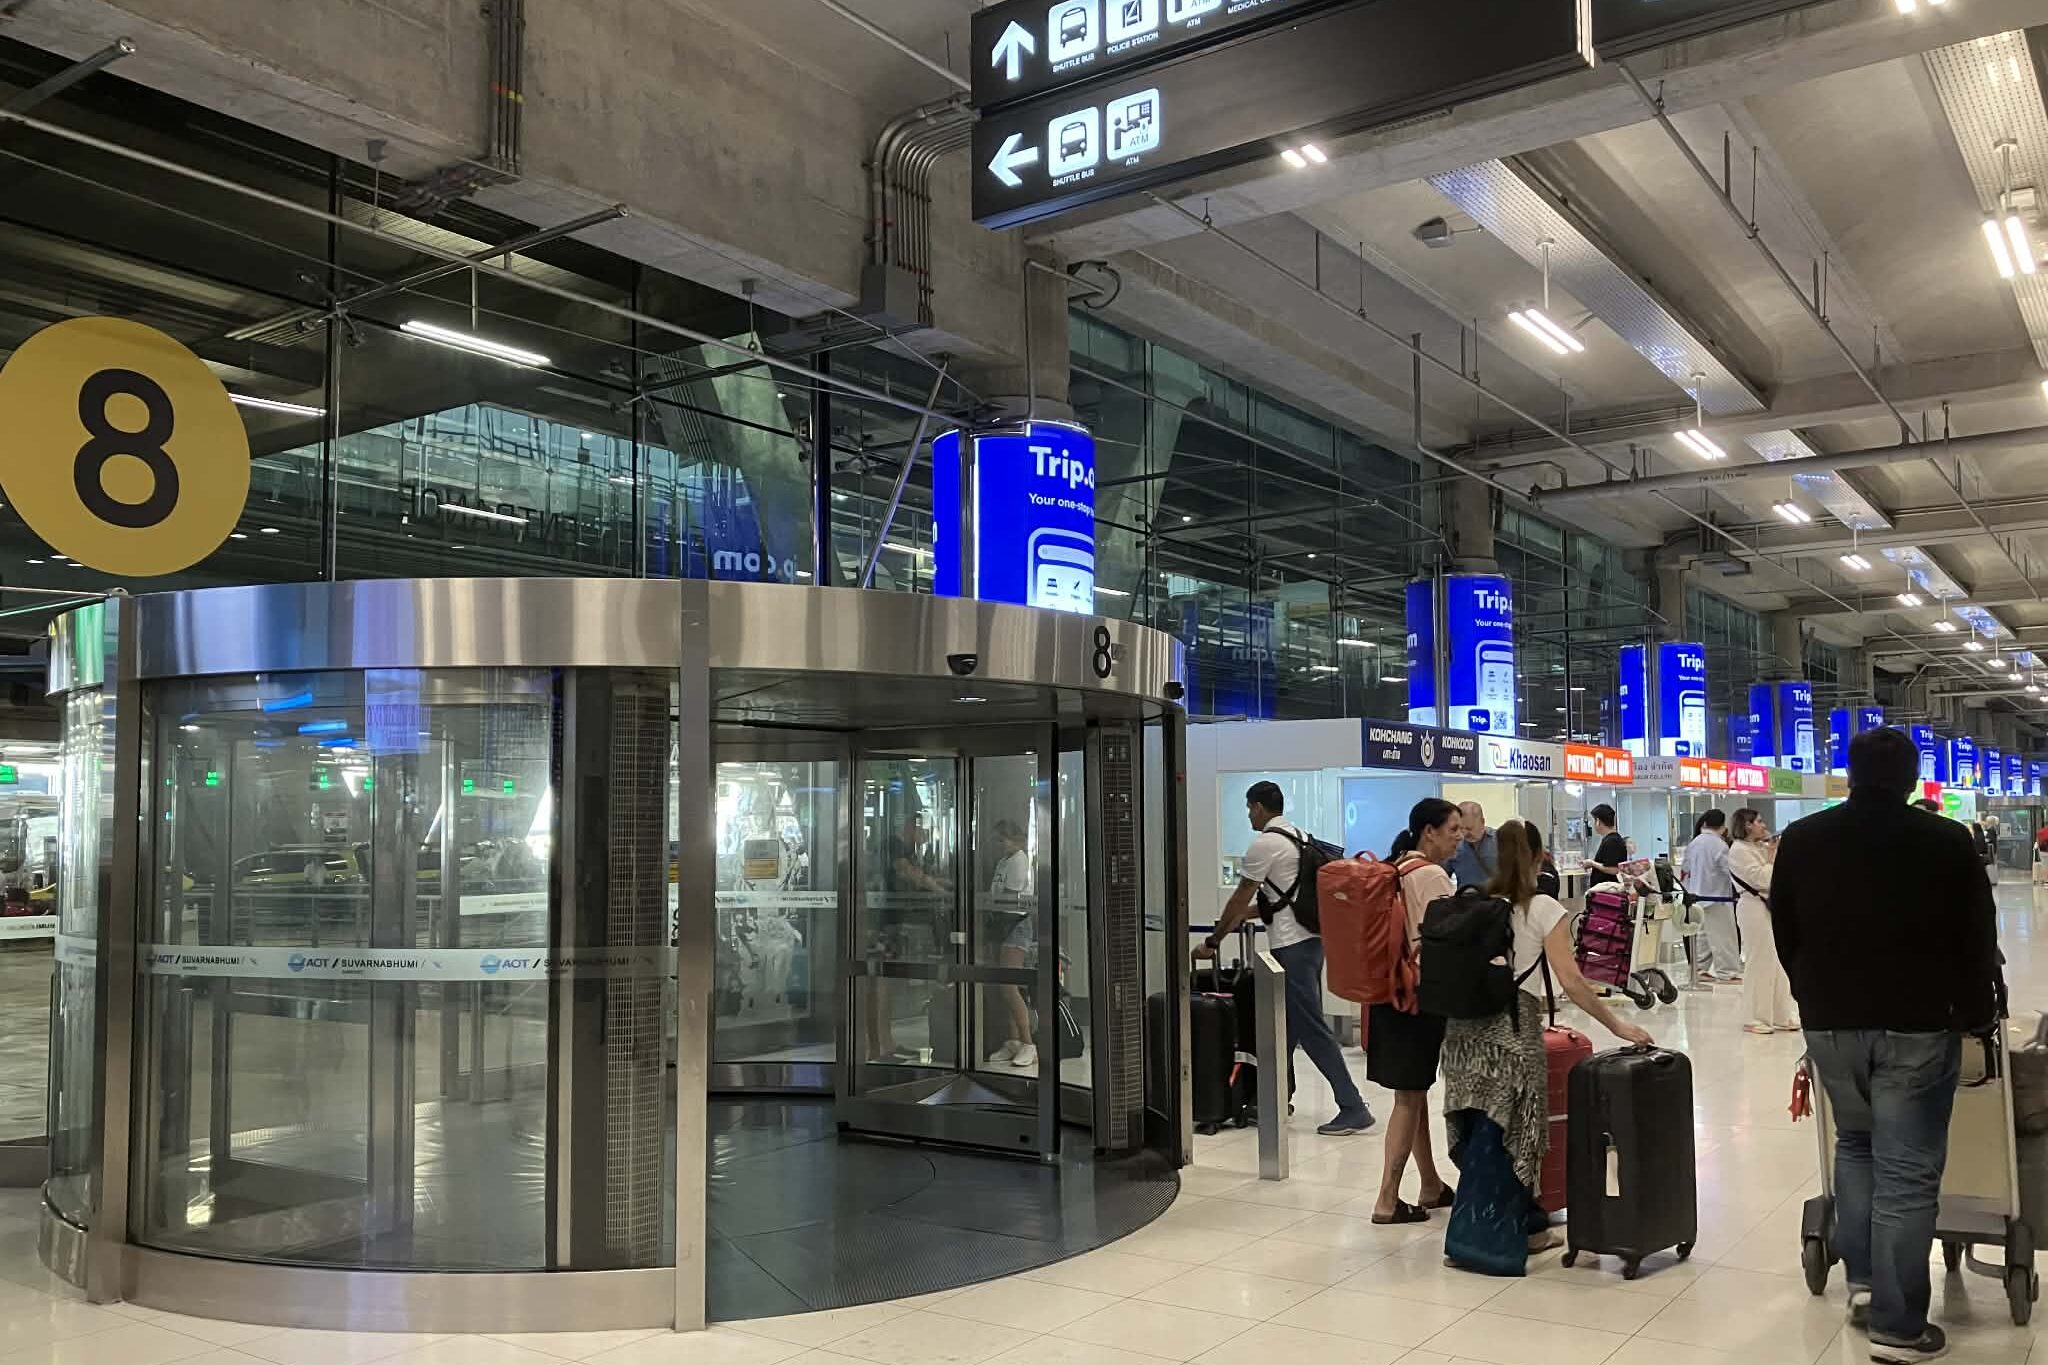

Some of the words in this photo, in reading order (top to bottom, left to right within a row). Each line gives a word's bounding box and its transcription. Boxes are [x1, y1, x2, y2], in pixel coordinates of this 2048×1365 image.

[1227, 0, 1259, 14] MEDICAL
[1186, 17, 1201, 29] ATM
[1106, 40, 1130, 54] POLICE
[1131, 32, 1159, 47] STATION
[1052, 57, 1081, 73] SHUTTLE
[1081, 53, 1095, 64] BUS
[1129, 133, 1149, 147] ATM
[1125, 155, 1139, 167] ATM
[1052, 171, 1080, 187] SHUTTLE
[1081, 168, 1095, 179] BUS
[73, 367, 180, 528] 8
[1028, 492, 1056, 506] Your
[1475, 618, 1493, 627] Your
[1093, 625, 1111, 679] 8
[1369, 727, 1413, 745] KOHCHANG
[1441, 735, 1474, 751] KOHKOOD
[1510, 747, 1551, 771] Khaosan
[182, 955, 239, 965] SUVARNABHUMI
[306, 958, 330, 968] AOT
[341, 958, 418, 968] SUVARNABHUMI
[502, 959, 529, 968] AOT
